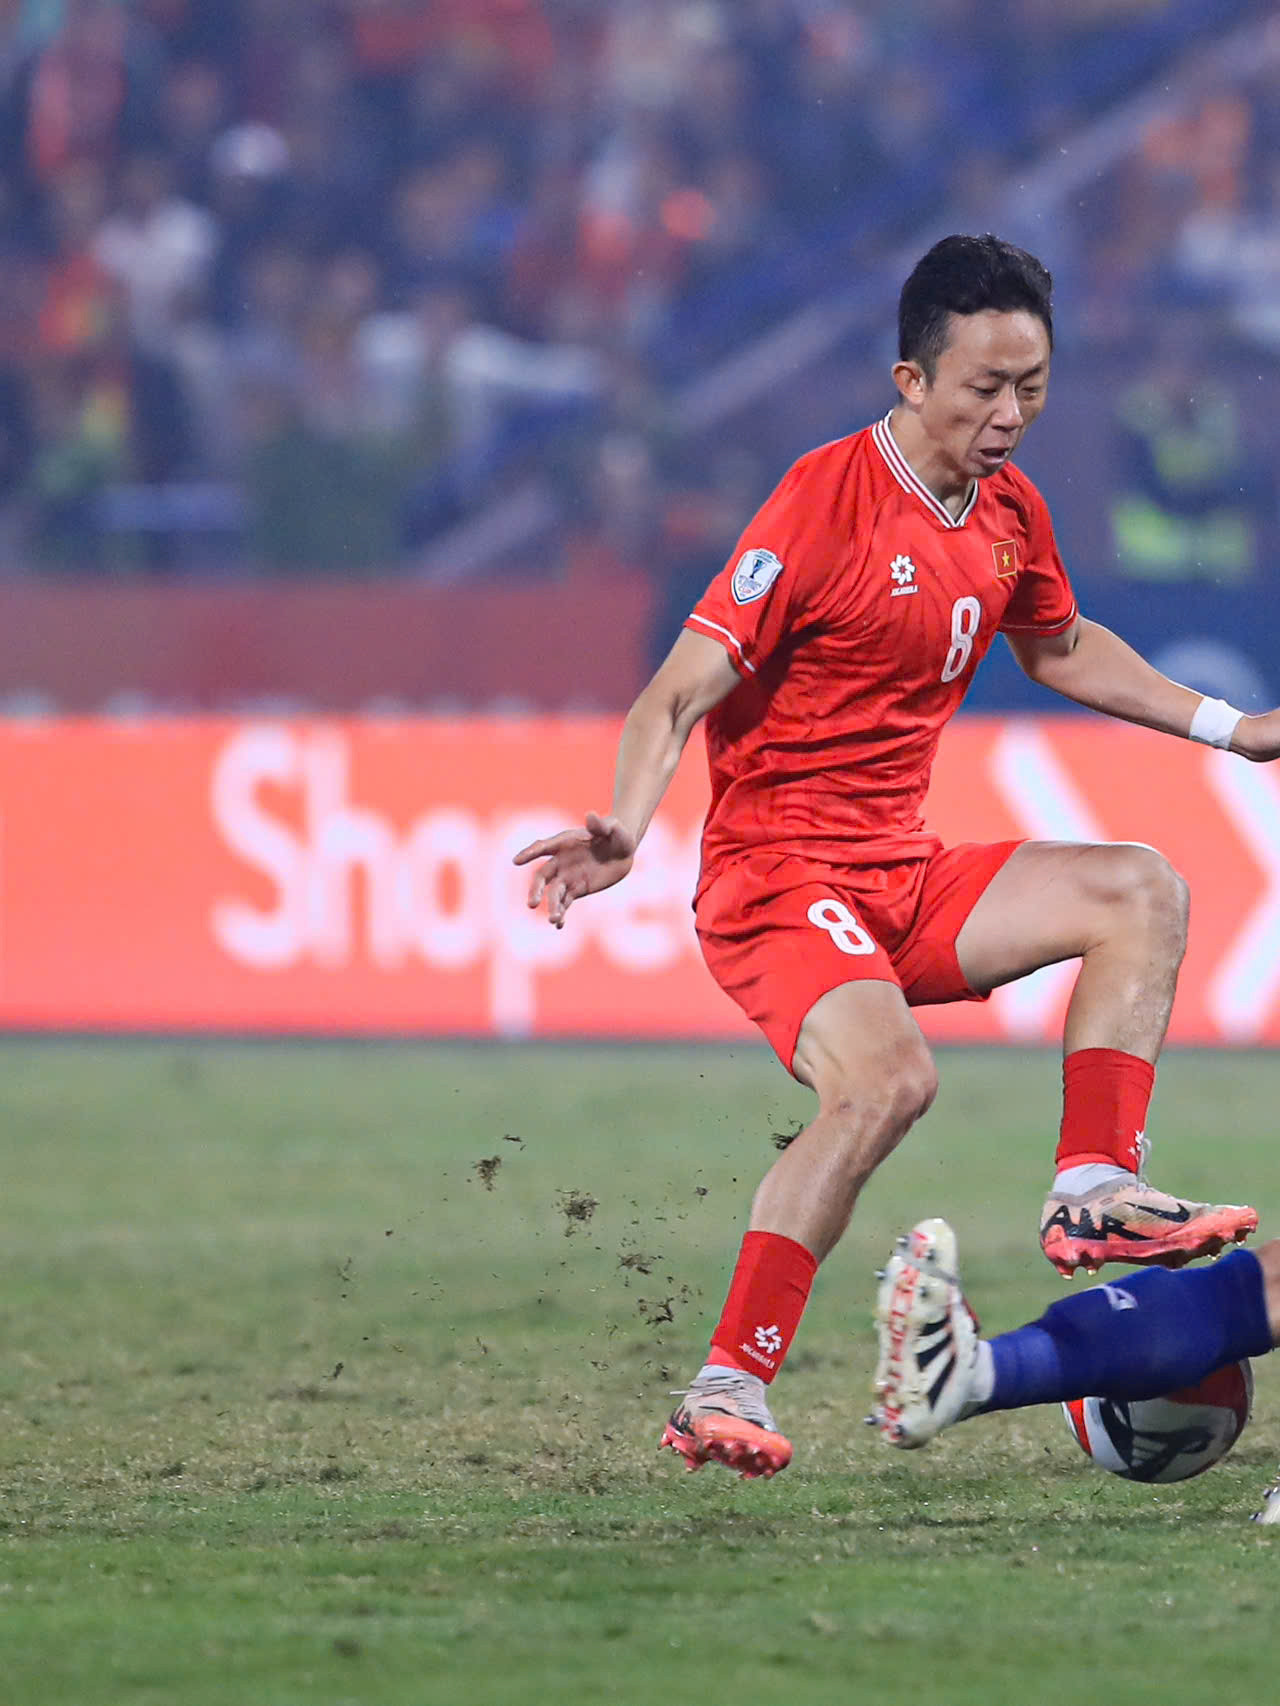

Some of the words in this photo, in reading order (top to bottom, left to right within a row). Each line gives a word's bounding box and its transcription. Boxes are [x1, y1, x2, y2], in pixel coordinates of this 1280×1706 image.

[941, 595, 982, 683] 8
[212, 722, 704, 1035] Shope
[807, 898, 877, 956] 8
